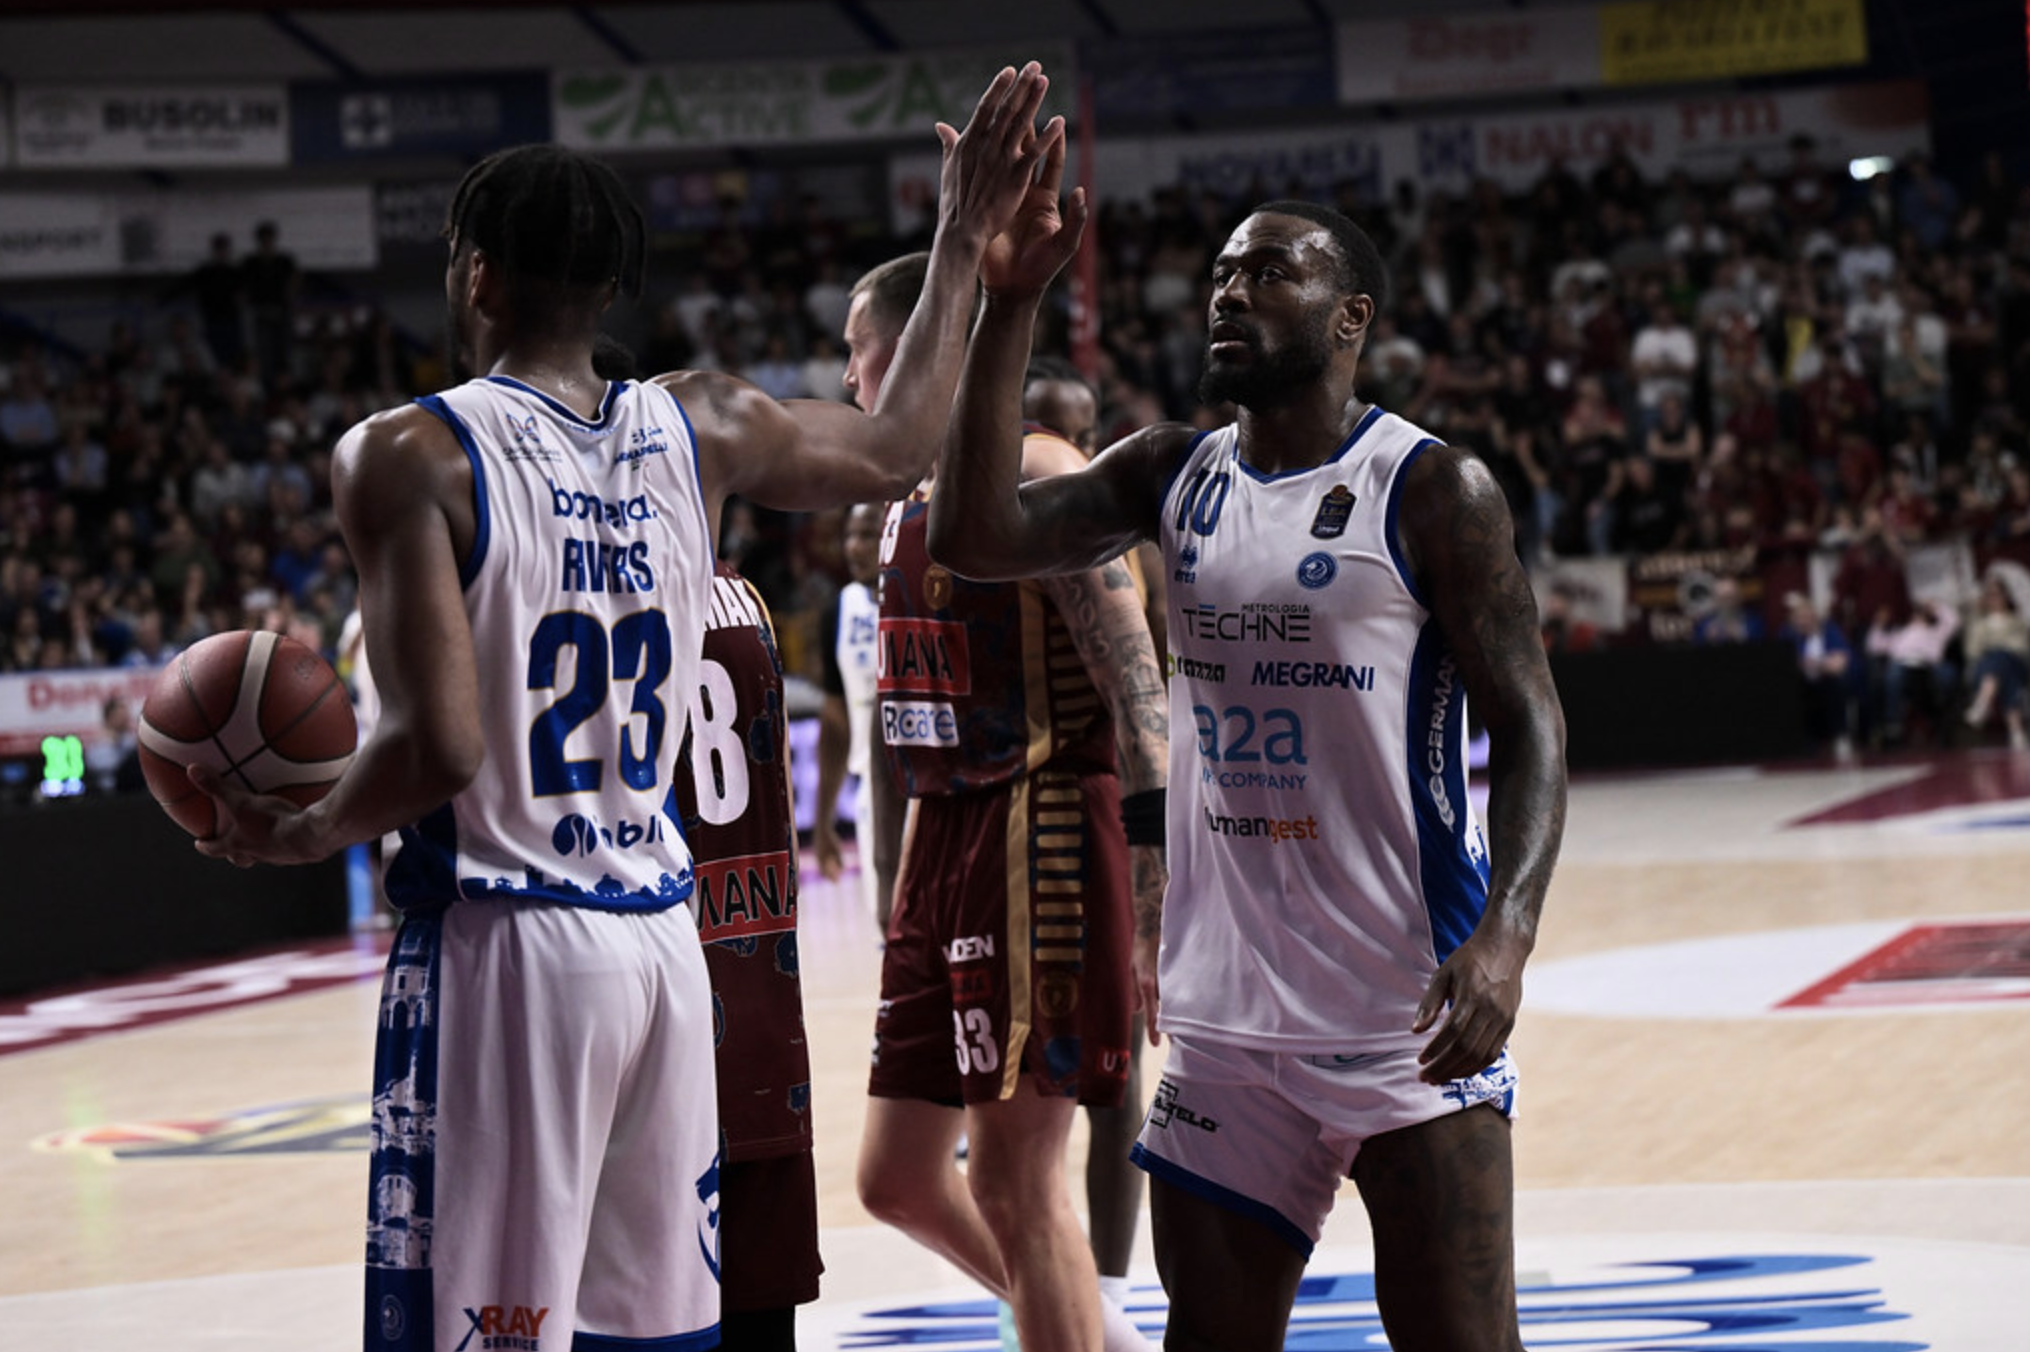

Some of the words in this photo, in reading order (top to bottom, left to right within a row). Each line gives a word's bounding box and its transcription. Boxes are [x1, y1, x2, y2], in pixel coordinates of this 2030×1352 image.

[104, 100, 278, 132] BUSOLIN
[1485, 119, 1654, 164] NALON
[1176, 467, 1230, 537] 10
[1182, 604, 1310, 642] TECHNE
[1241, 603, 1310, 614] METROLOGIA
[1251, 661, 1374, 691] MEGRANI
[527, 609, 672, 799] 23
[692, 658, 749, 826] 8
[1193, 705, 1308, 766] a2a
[1219, 772, 1308, 790] COMPANY
